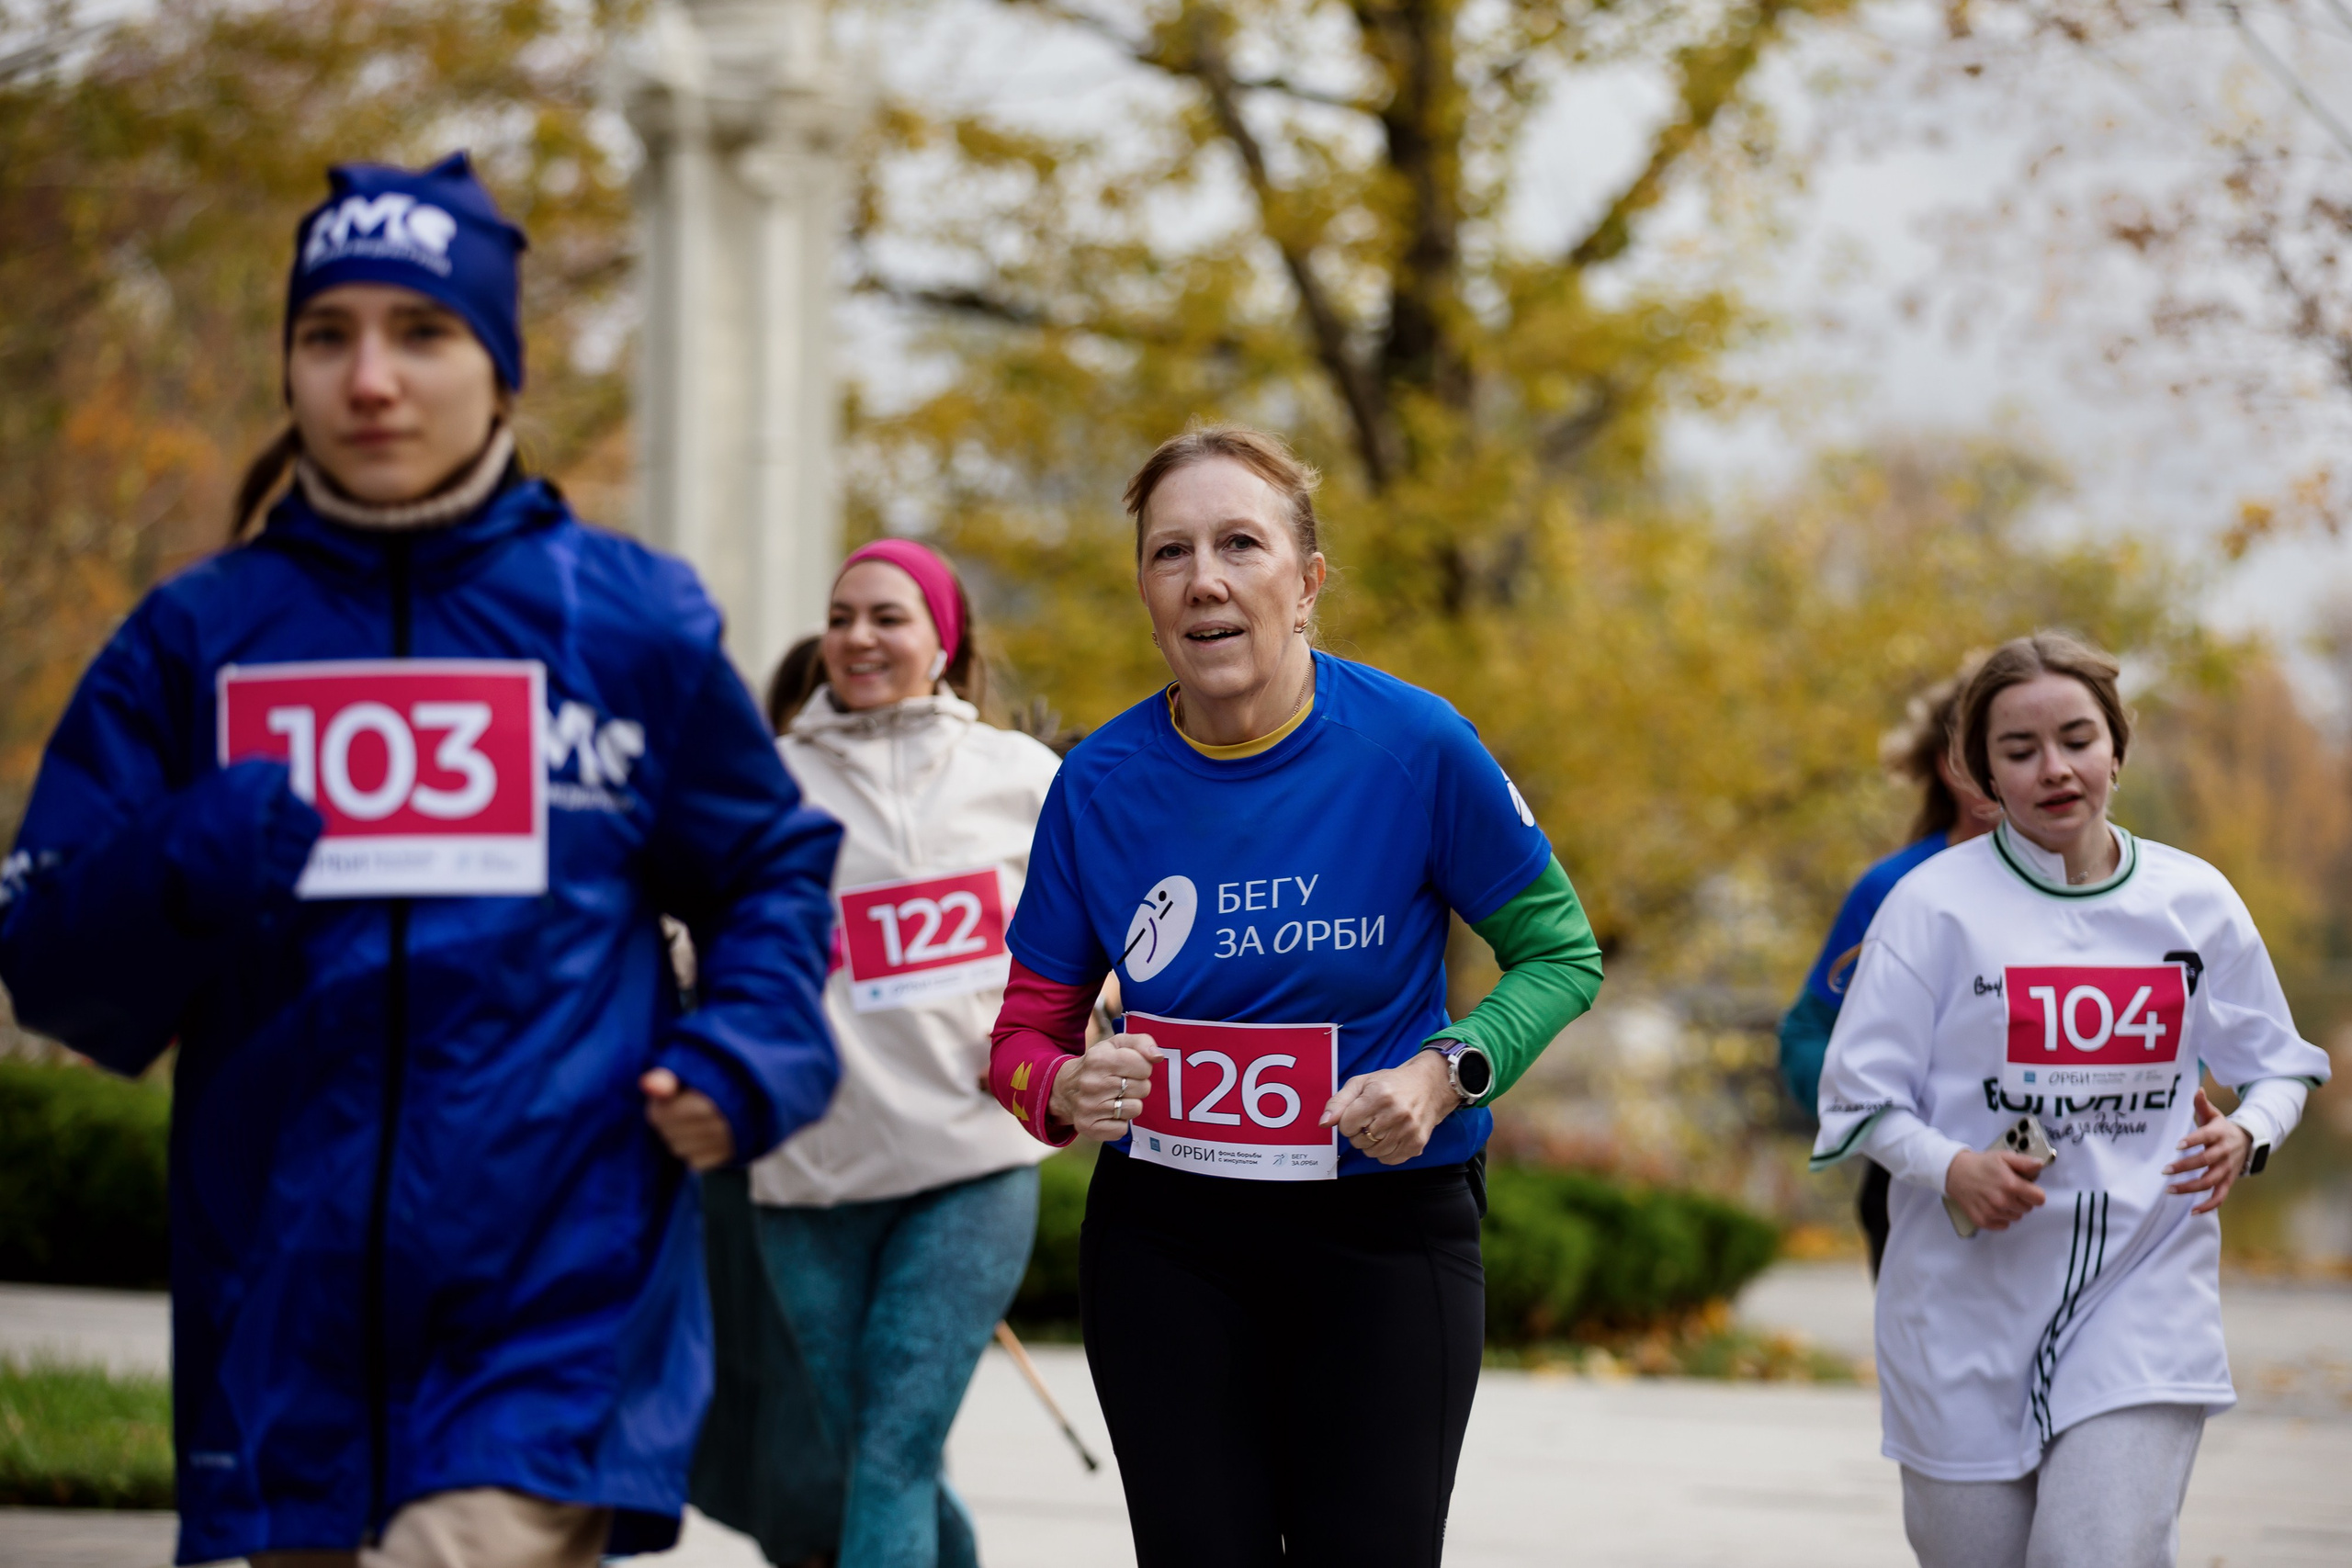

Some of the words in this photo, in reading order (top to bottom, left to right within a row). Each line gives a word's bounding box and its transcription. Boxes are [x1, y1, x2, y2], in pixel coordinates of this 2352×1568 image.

[266, 700, 498, 820] 103
[1218, 874, 1319, 914] БЕГУ
[868, 891, 987, 966] 122
[1214, 925, 1265, 959] ЗА
[1272, 915, 1385, 954] ОРБИ
[2029, 984, 2166, 1052] 104
[1158, 1046, 1302, 1129] 126
[1171, 1144, 1216, 1163] ОРБИ
[1217, 1150, 1236, 1158] фонд
